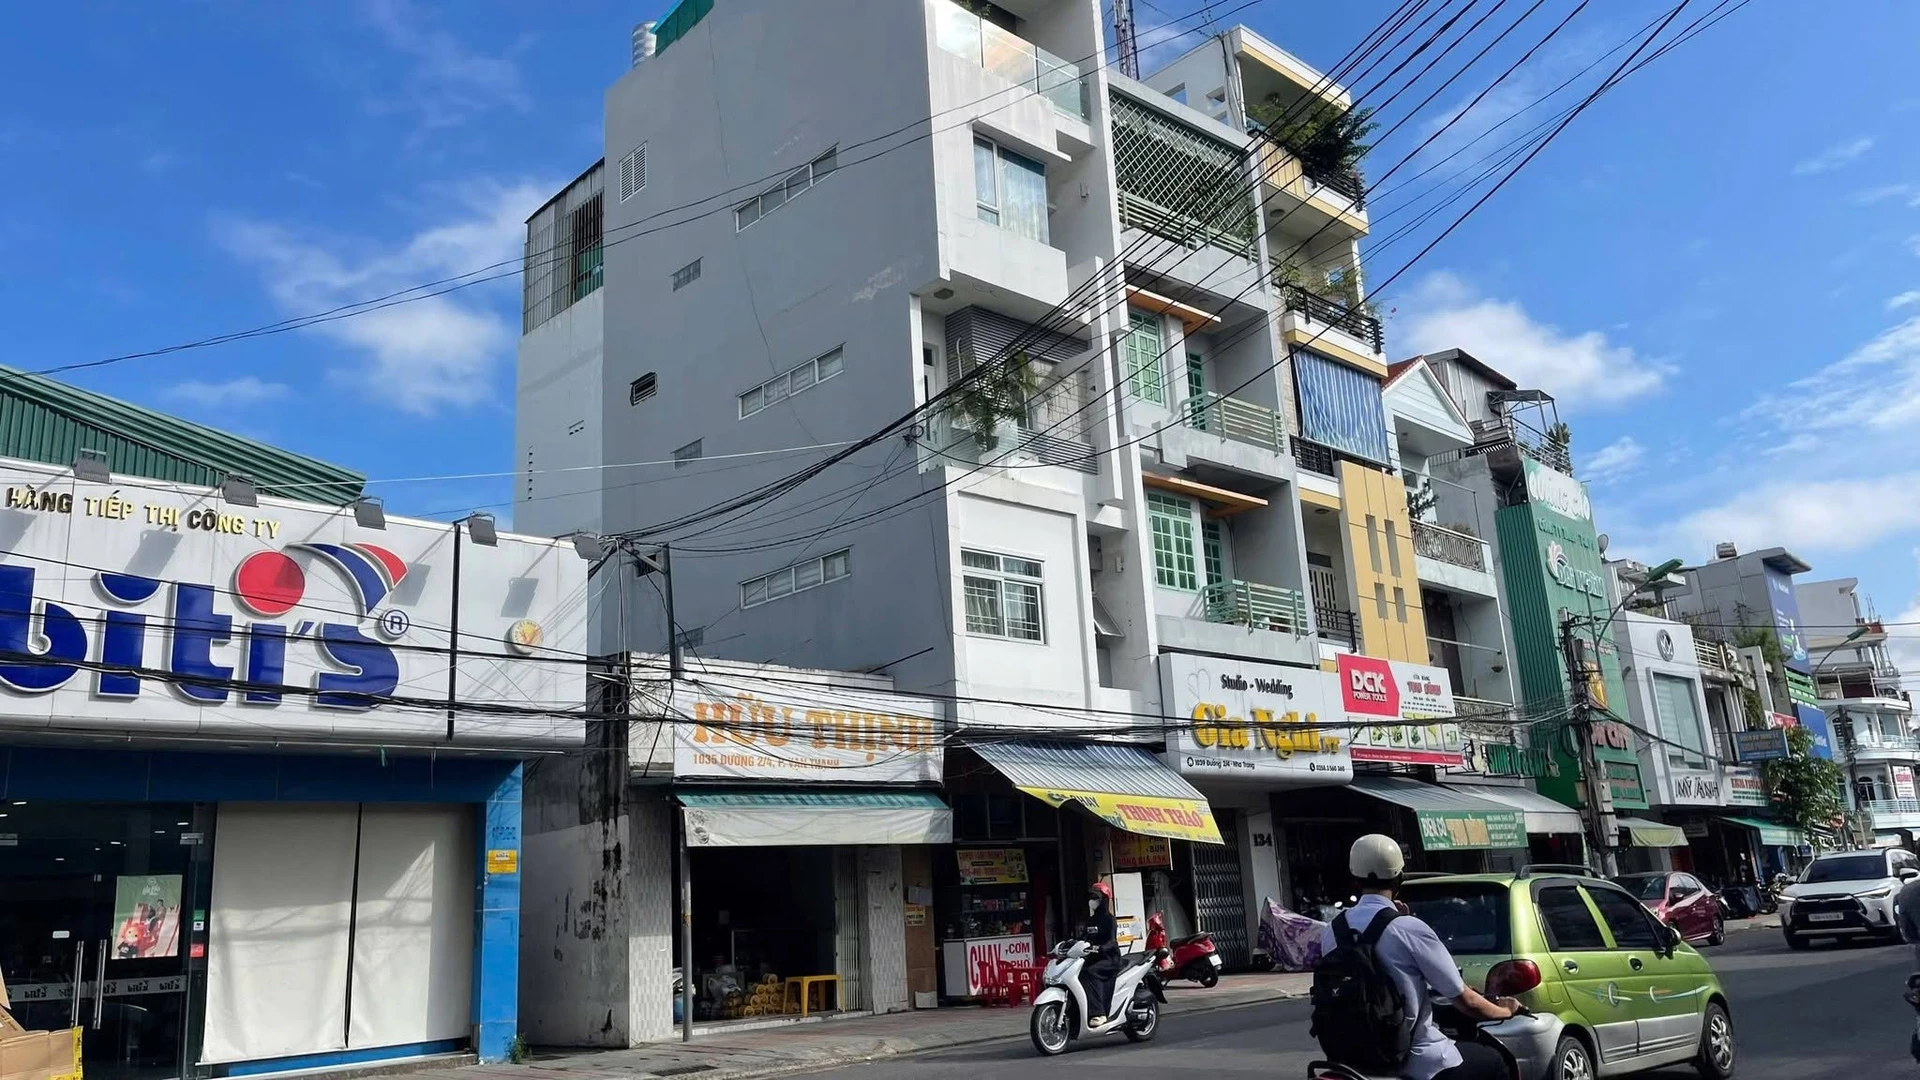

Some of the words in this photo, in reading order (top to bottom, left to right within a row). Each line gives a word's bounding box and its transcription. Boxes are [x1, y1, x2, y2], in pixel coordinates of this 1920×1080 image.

[5, 484, 73, 513] HÀNG
[84, 490, 135, 520] TIẾP
[143, 504, 181, 532] THỊ
[187, 508, 245, 535] CÔNG
[252, 518, 281, 539] TY
[1220, 673, 1248, 691] Studio
[1254, 677, 1294, 700] Wedding
[1350, 669, 1387, 694] DCK
[1353, 691, 1372, 701] POWER
[693, 692, 792, 747] HỮU
[805, 709, 934, 765] THỊNH
[1191, 701, 1250, 749] Gia
[693, 754, 717, 765] 1035
[1253, 833, 1273, 847] 134
[1009, 941, 1030, 954] CƠM
